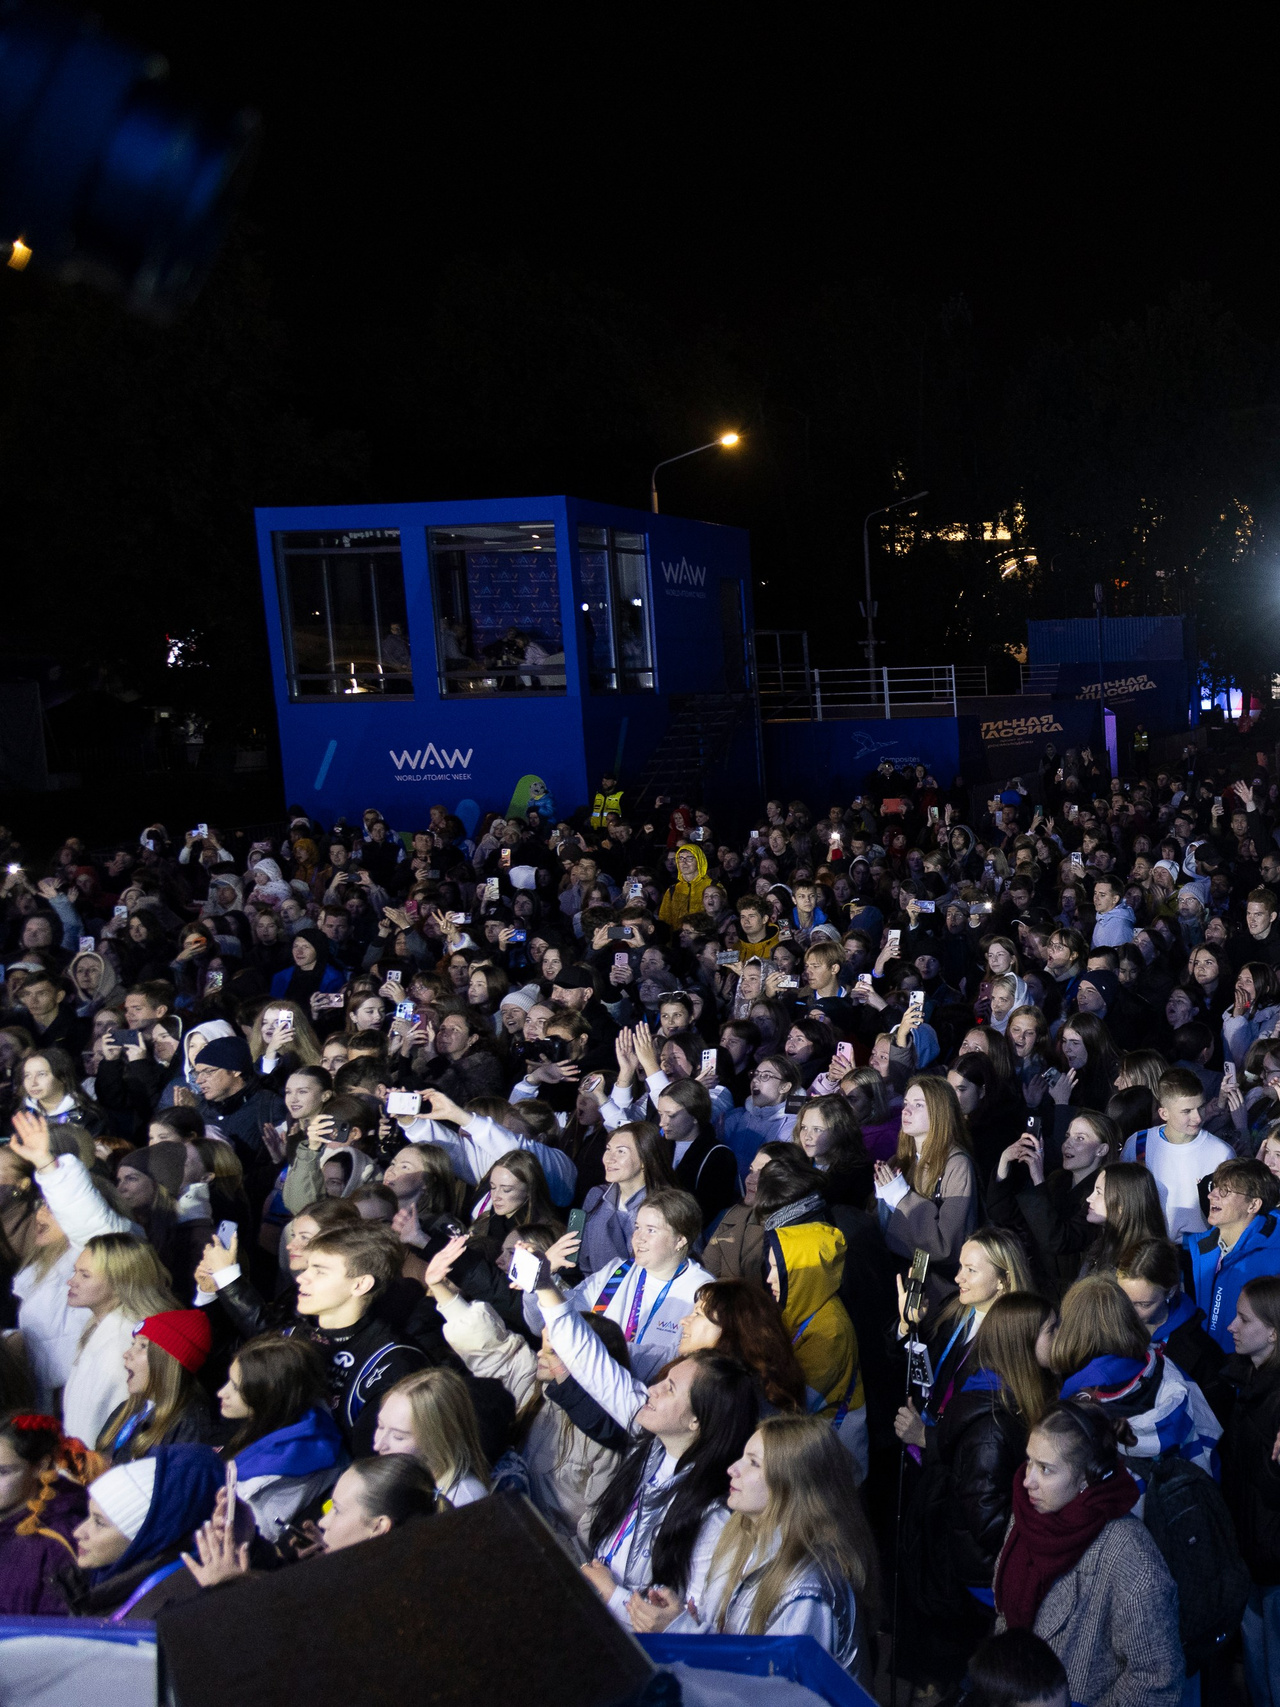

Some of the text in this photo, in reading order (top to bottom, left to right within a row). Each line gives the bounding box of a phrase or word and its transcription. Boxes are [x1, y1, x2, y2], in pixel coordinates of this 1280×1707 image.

[661, 556, 706, 587] WAW
[980, 714, 1054, 732] ЛИЧНАЯ
[389, 742, 473, 770] WAW
[1210, 1286, 1224, 1331] NORDSKI
